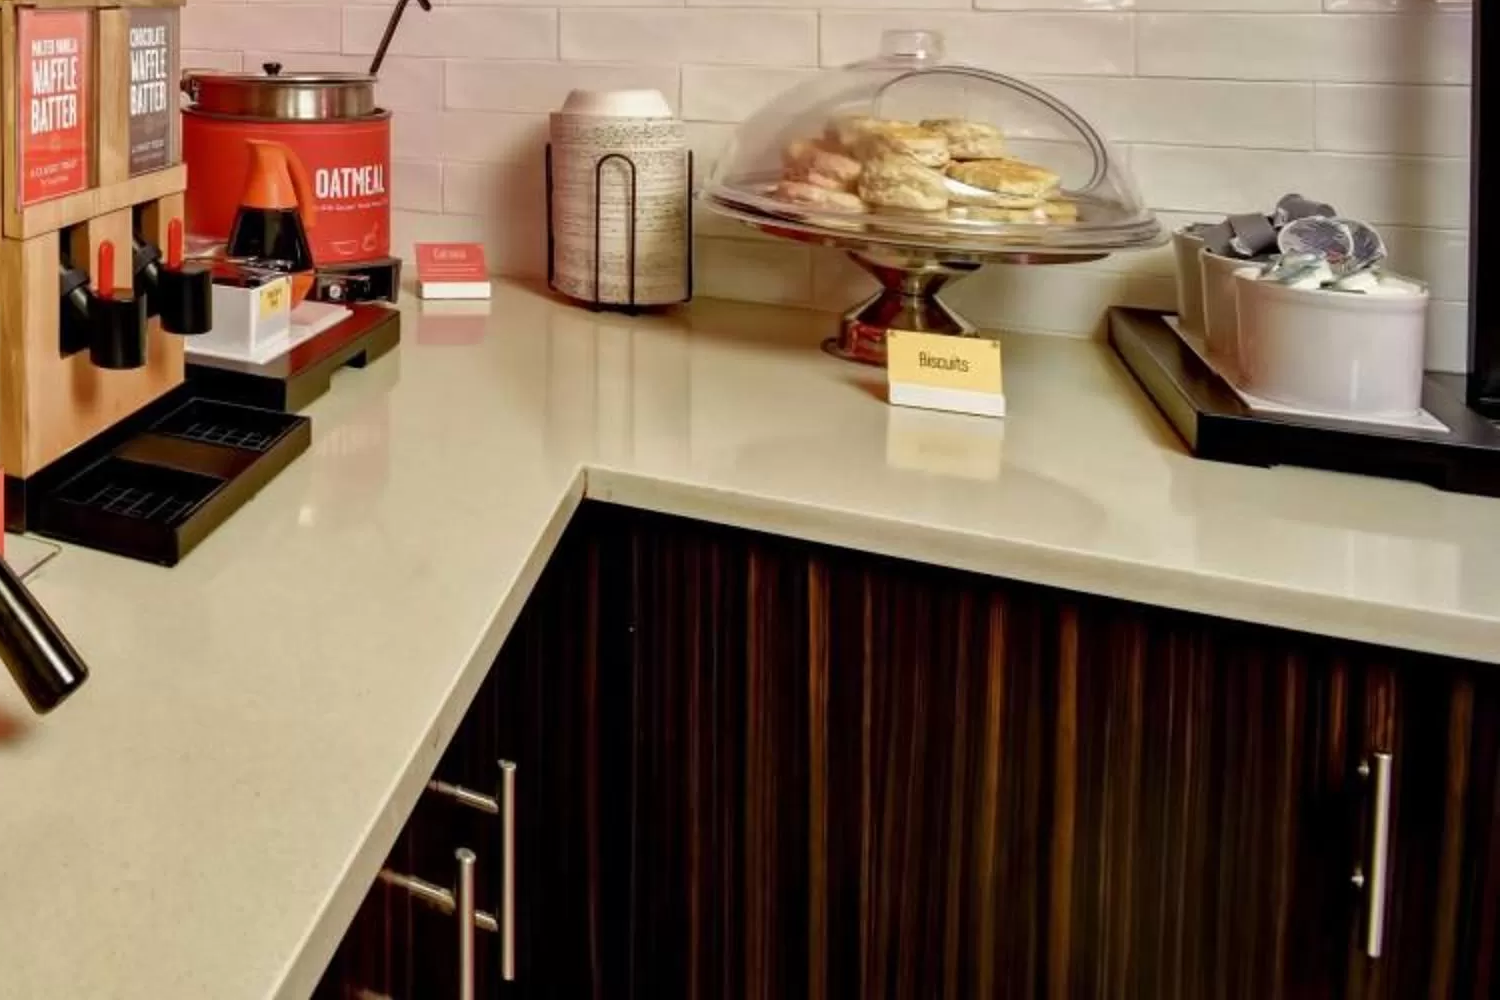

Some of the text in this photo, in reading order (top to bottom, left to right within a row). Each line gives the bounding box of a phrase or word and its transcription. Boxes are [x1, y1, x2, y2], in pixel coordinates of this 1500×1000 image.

[129, 26, 167, 48] CHOCOLATE
[31, 56, 78, 95] WAFFLE
[129, 47, 168, 82] WAFFLE
[31, 93, 78, 135] BATTER
[130, 81, 168, 116] BATTER
[315, 164, 385, 199] OATMEAL
[918, 351, 970, 373] Biscuits
